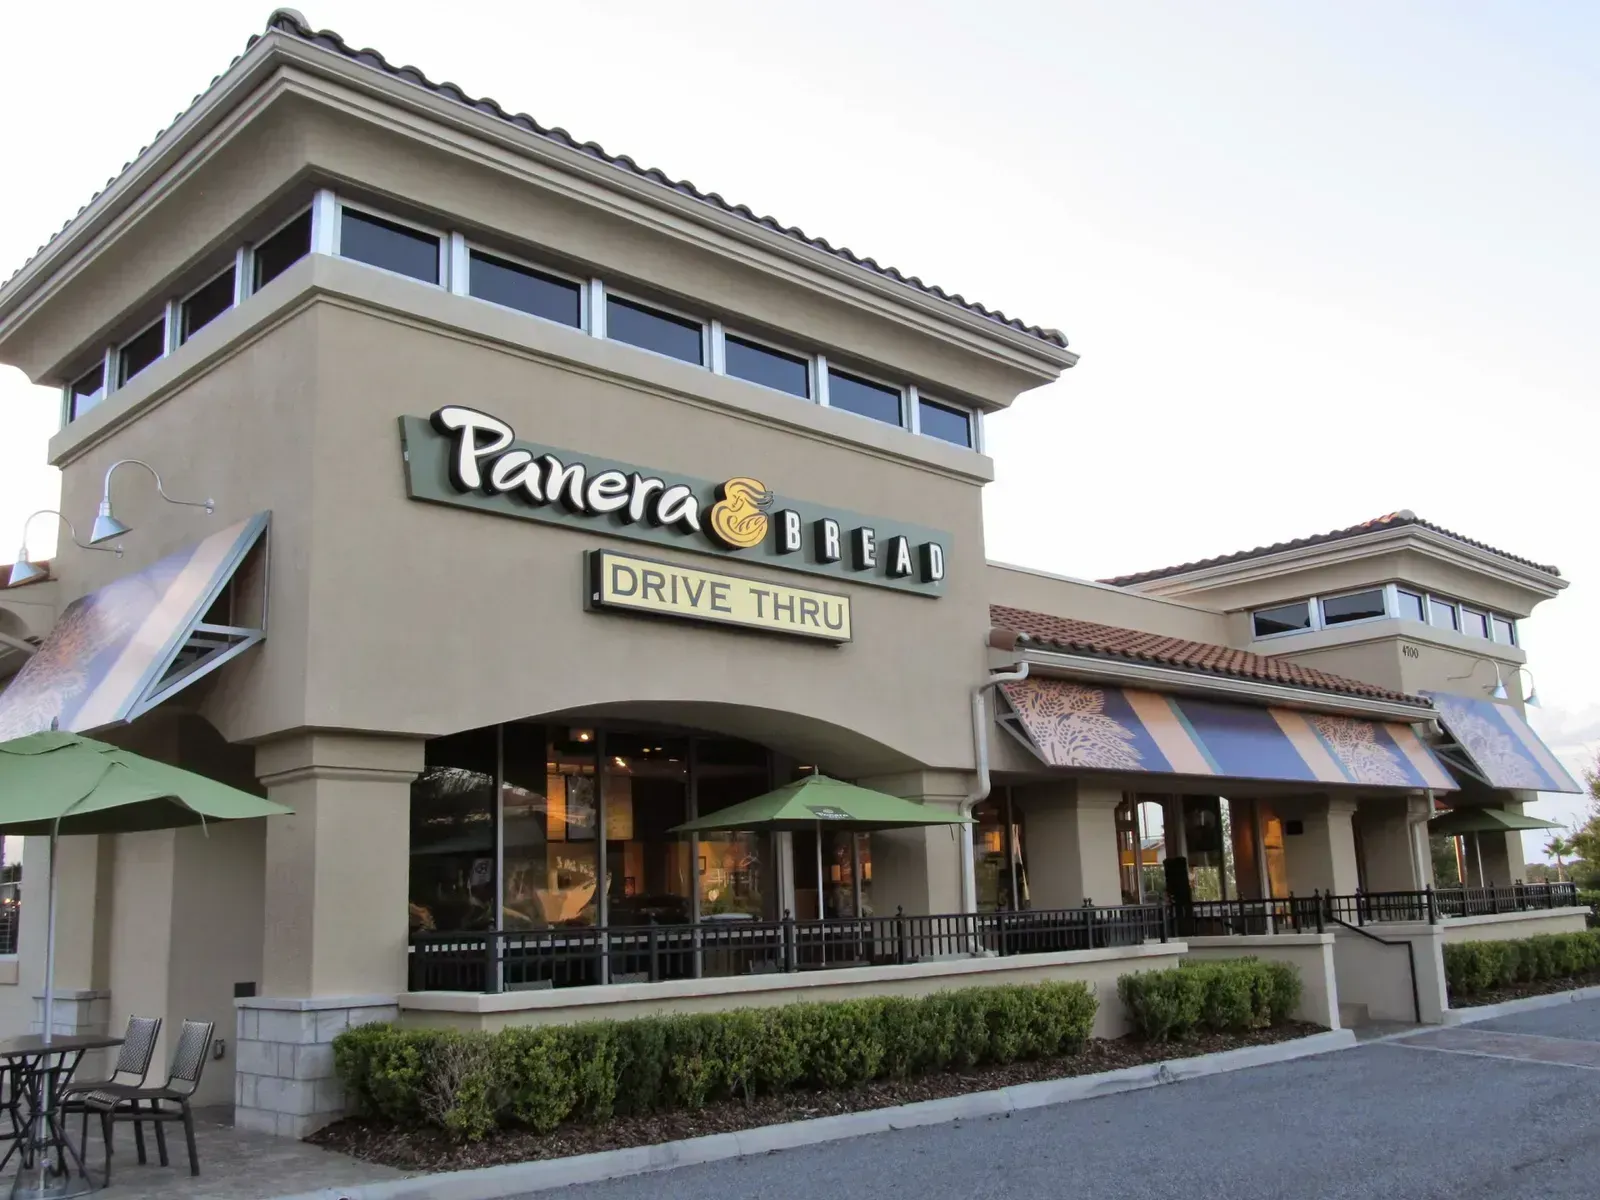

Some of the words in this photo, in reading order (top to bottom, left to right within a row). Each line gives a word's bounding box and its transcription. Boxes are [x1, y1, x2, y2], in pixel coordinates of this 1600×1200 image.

[433, 405, 700, 533] Panera
[778, 509, 945, 582] BREAD
[611, 563, 731, 613] DRIVE
[749, 587, 843, 630] THRU
